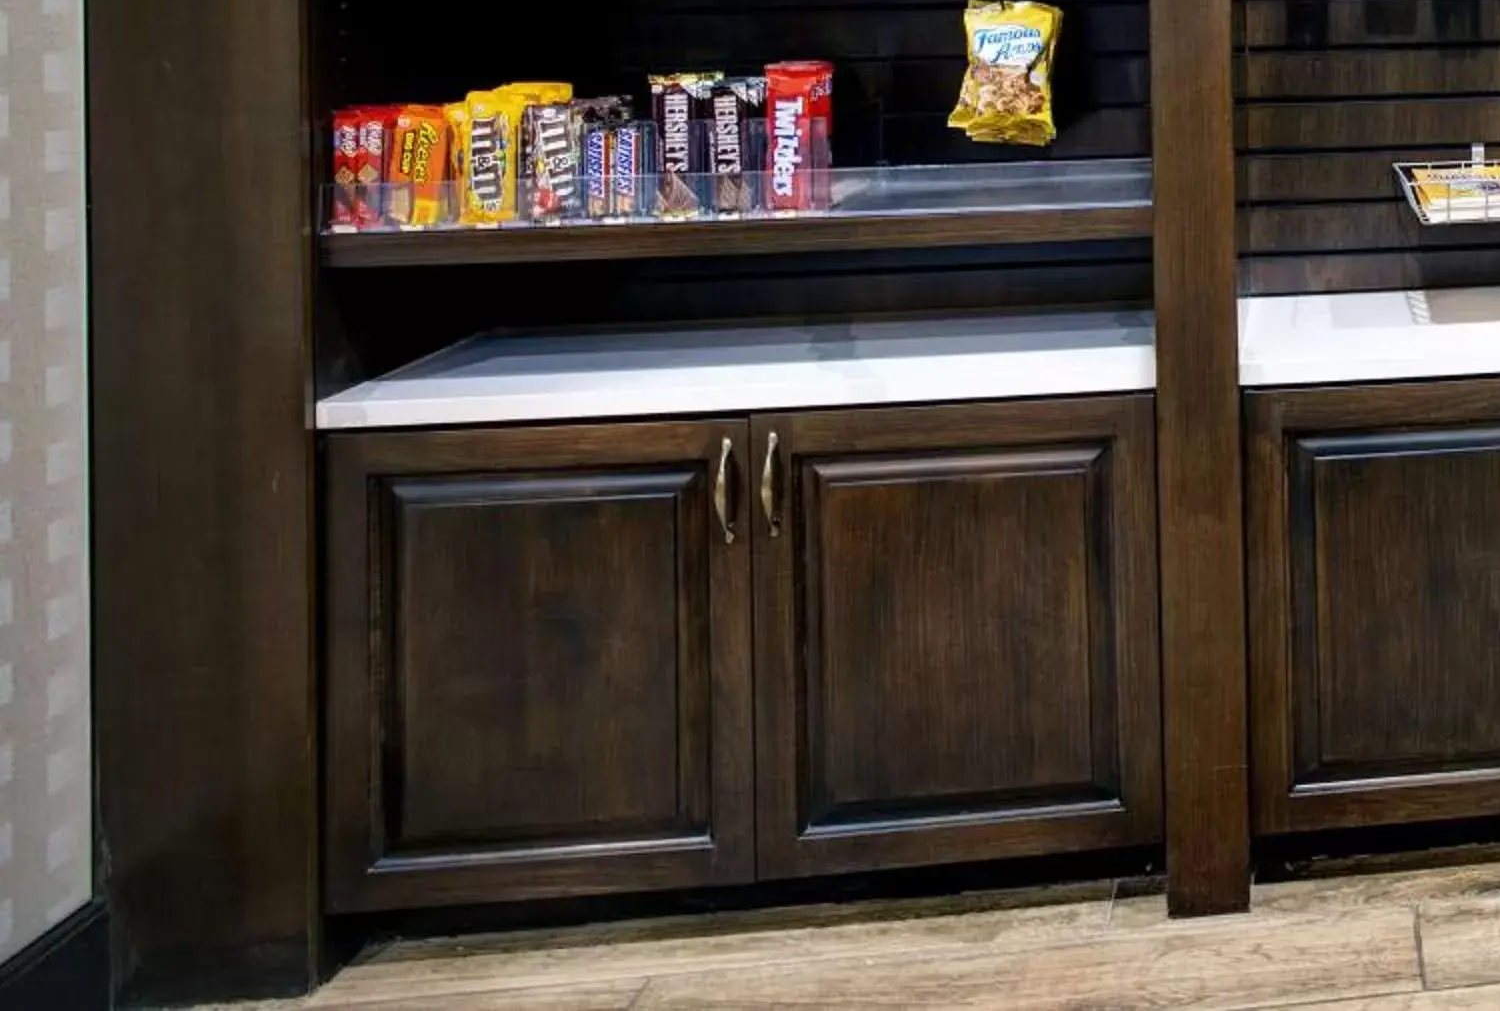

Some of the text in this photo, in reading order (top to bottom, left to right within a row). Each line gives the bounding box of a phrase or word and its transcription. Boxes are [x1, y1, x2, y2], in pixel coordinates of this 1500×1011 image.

[974, 28, 1042, 54] Famous
[664, 93, 689, 172] HERSHEY'S
[713, 94, 741, 173] HERSHEY'S
